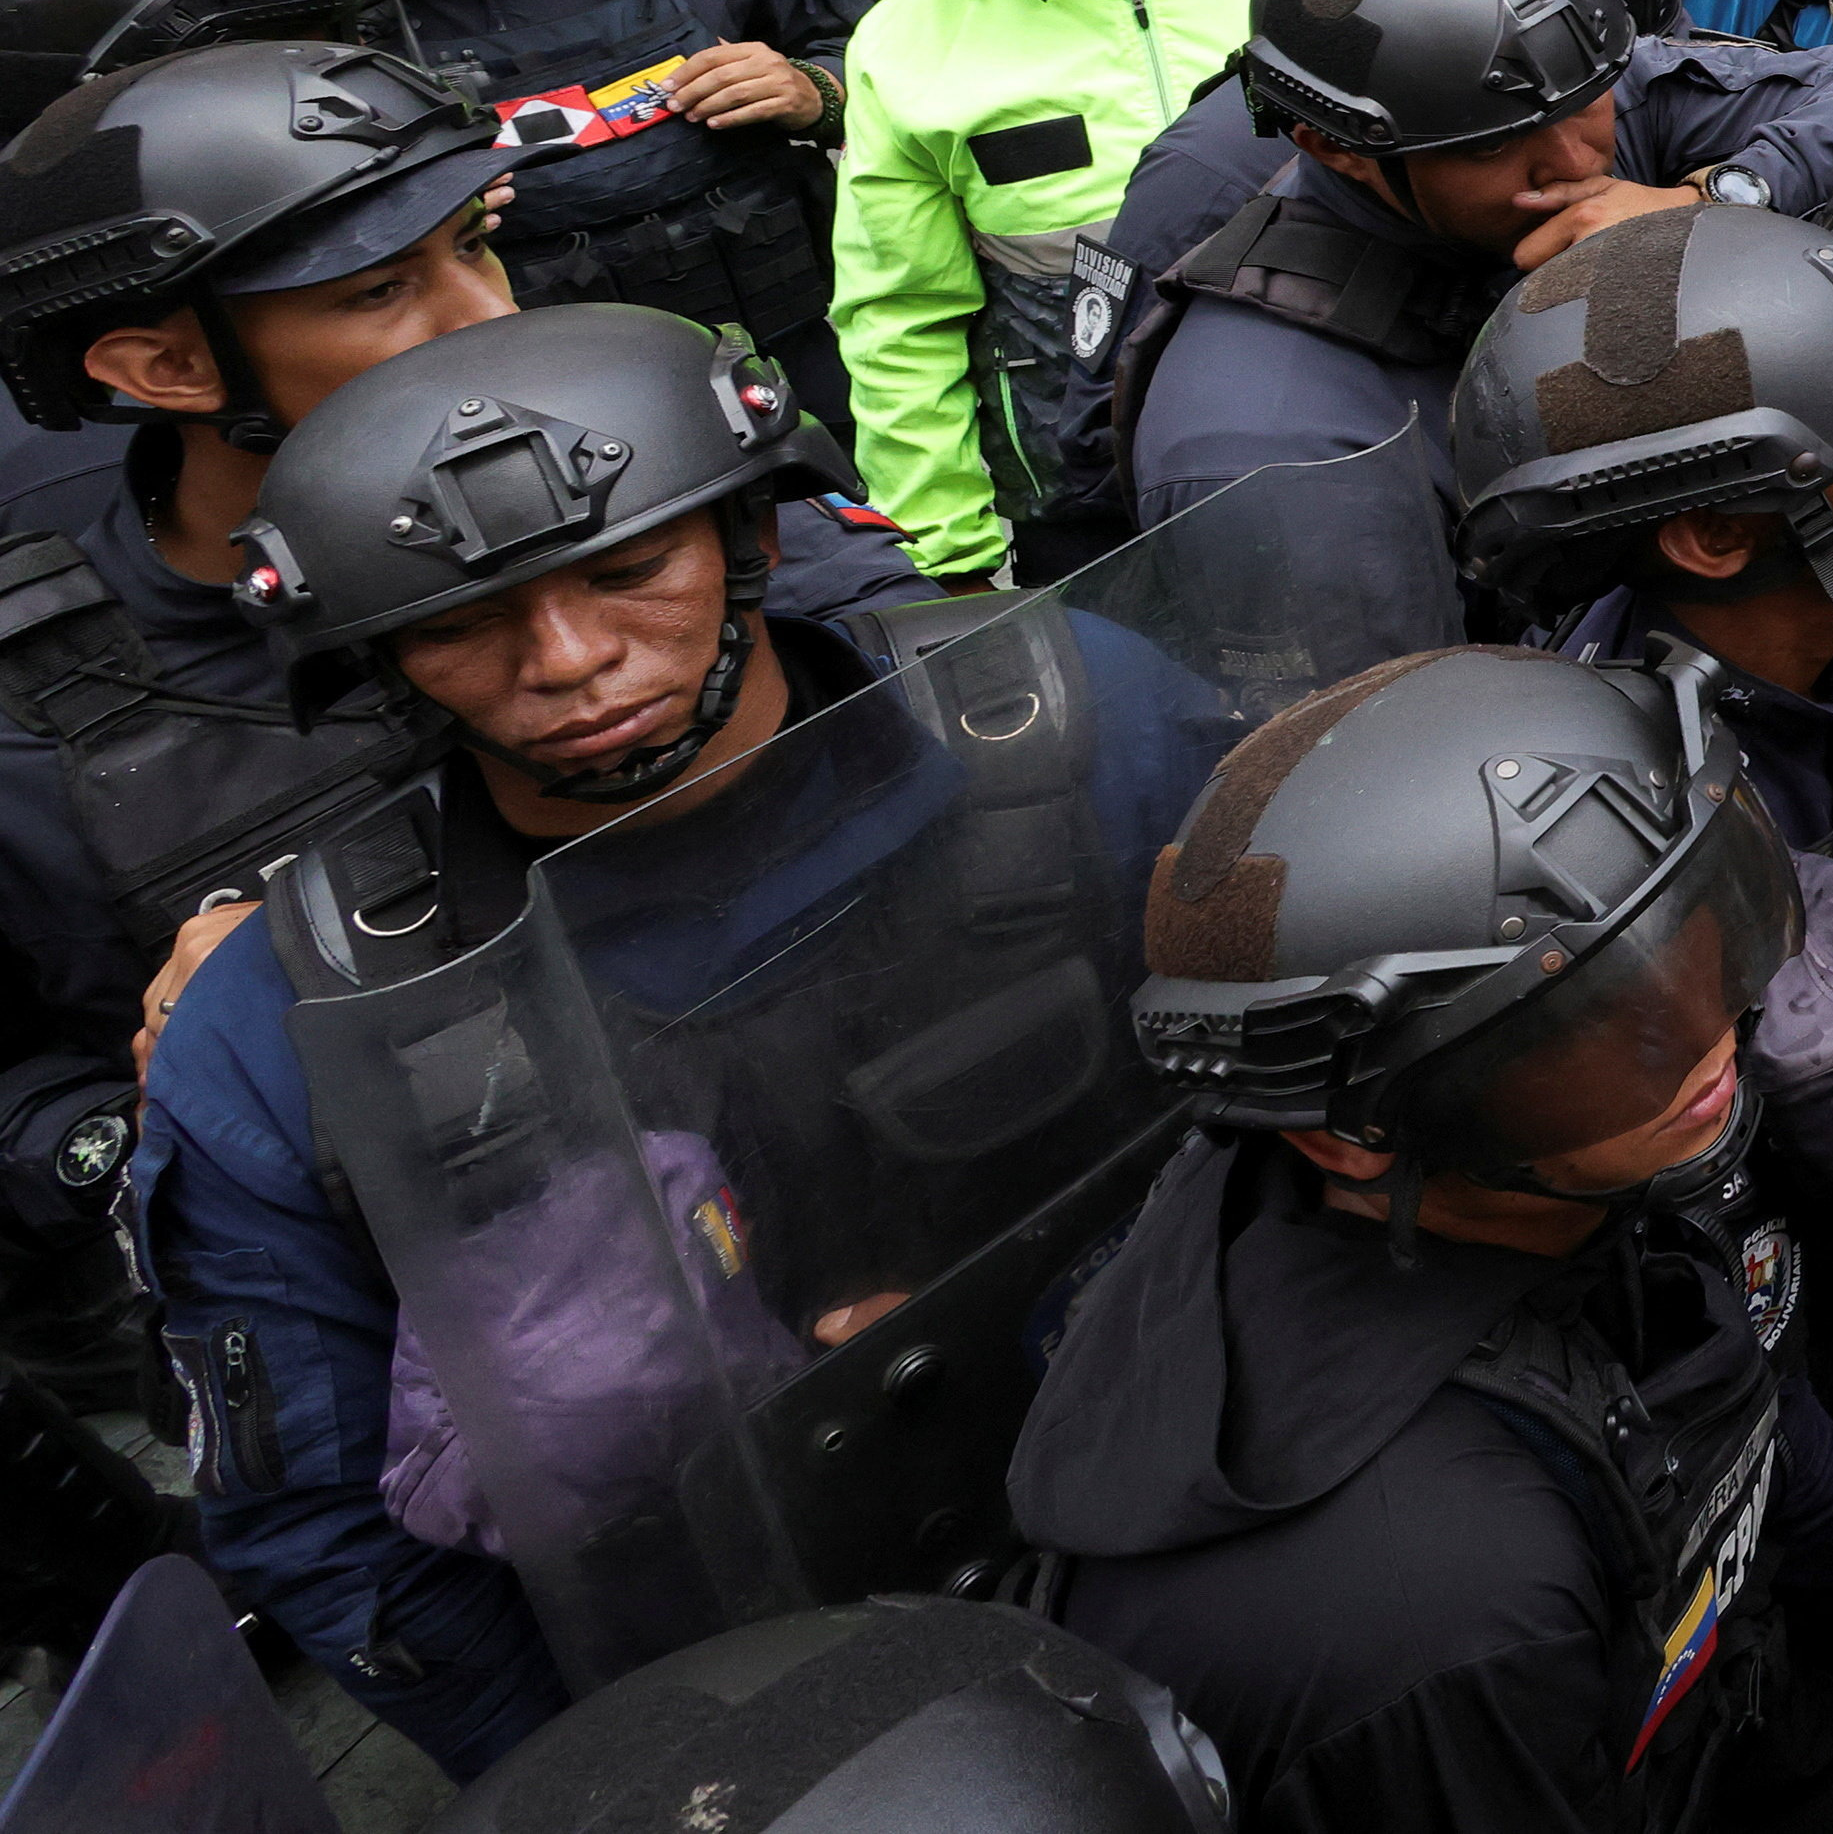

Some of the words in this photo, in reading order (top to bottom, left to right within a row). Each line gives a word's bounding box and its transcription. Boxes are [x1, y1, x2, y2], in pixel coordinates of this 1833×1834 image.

[1073, 259, 1128, 301] MOTORIZADA
[1076, 241, 1134, 284] DIVISIÓN
[1763, 1243, 1801, 1352] BOLIVARIANA
